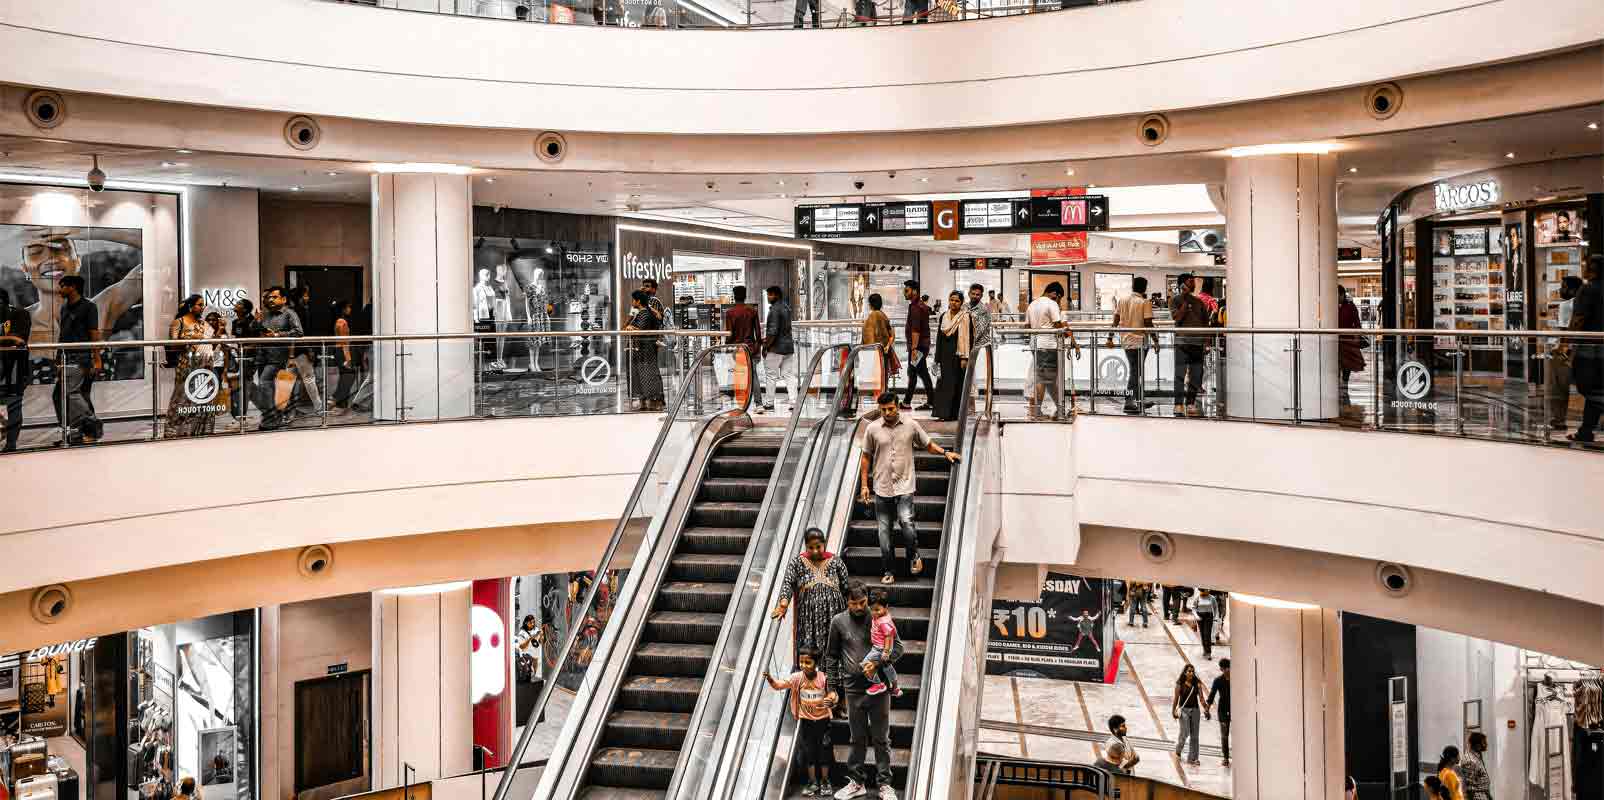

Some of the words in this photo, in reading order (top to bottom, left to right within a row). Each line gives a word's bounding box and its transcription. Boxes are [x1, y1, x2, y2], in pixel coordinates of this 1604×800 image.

[1434, 182, 1491, 208] PARCOS
[937, 210, 953, 229] G
[623, 252, 673, 283] lifestyle
[27, 637, 98, 662] LOUNGE
